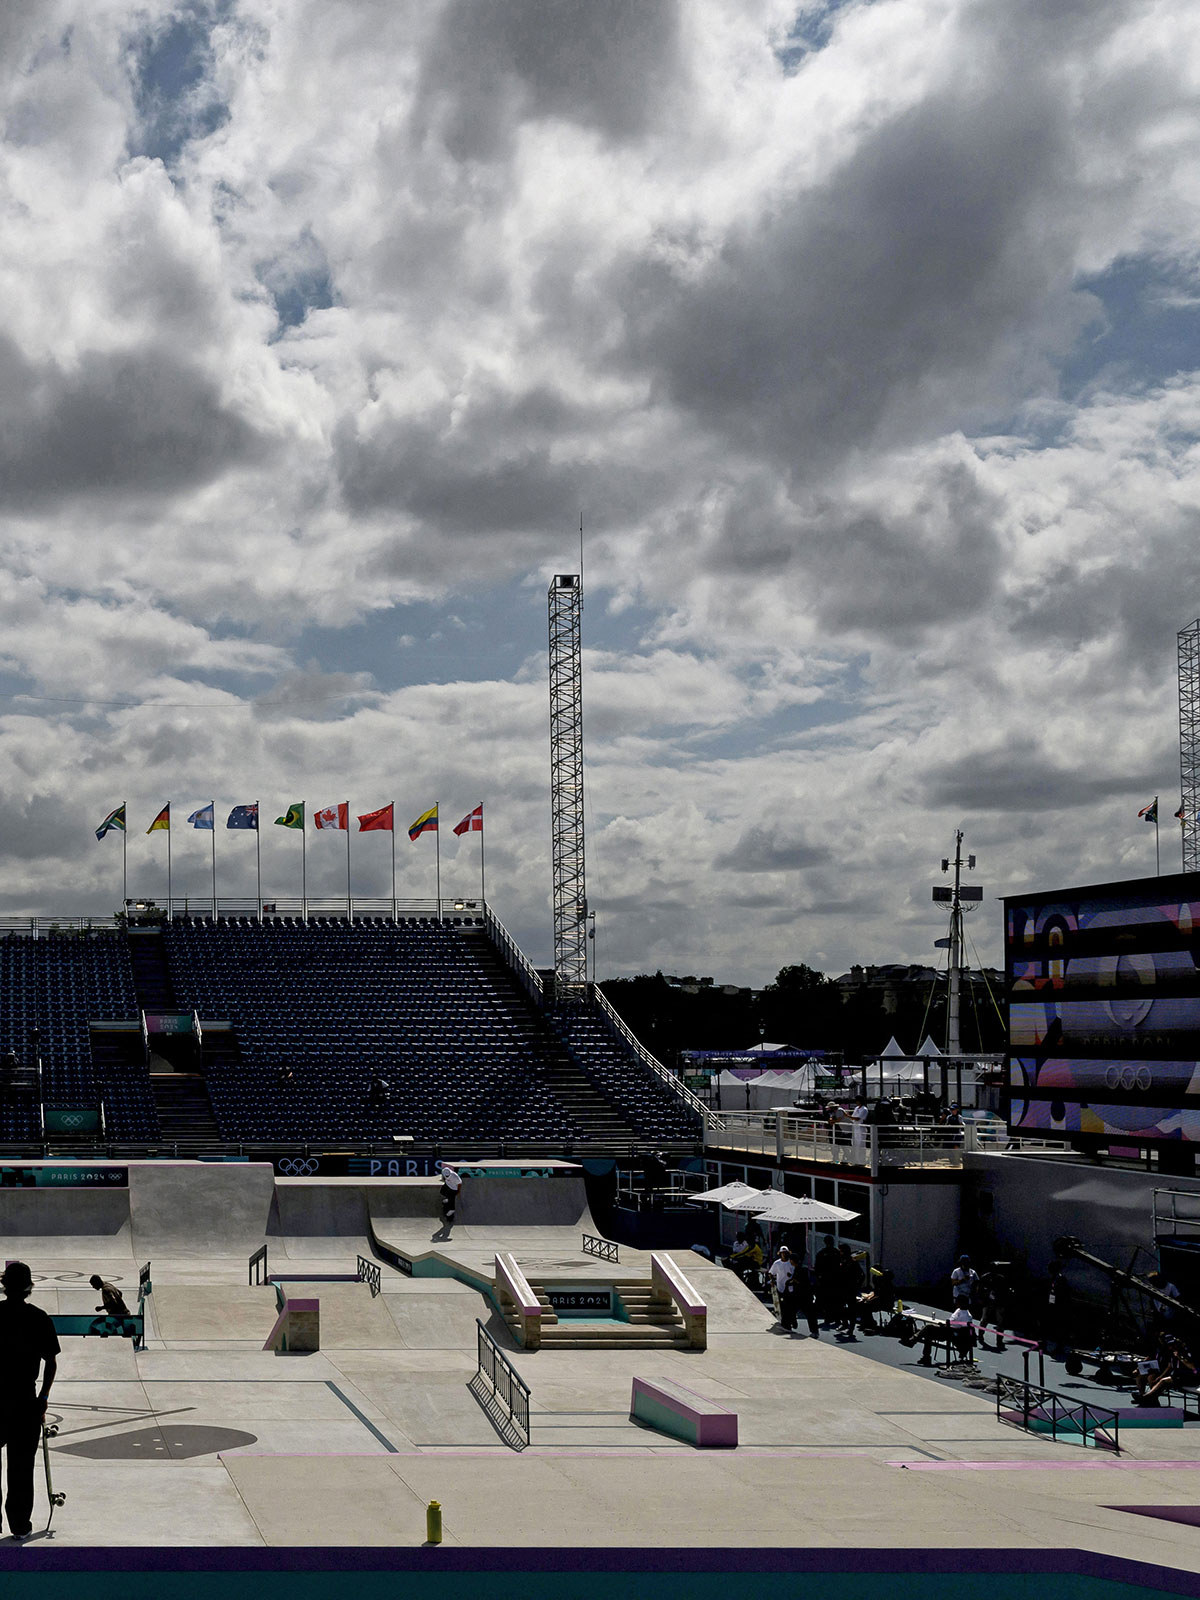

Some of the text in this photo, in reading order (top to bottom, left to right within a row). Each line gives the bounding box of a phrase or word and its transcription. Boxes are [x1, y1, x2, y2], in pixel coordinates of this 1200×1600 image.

[51, 1173, 105, 1181] PARIS 2024
[579, 1296, 608, 1305] 2024
